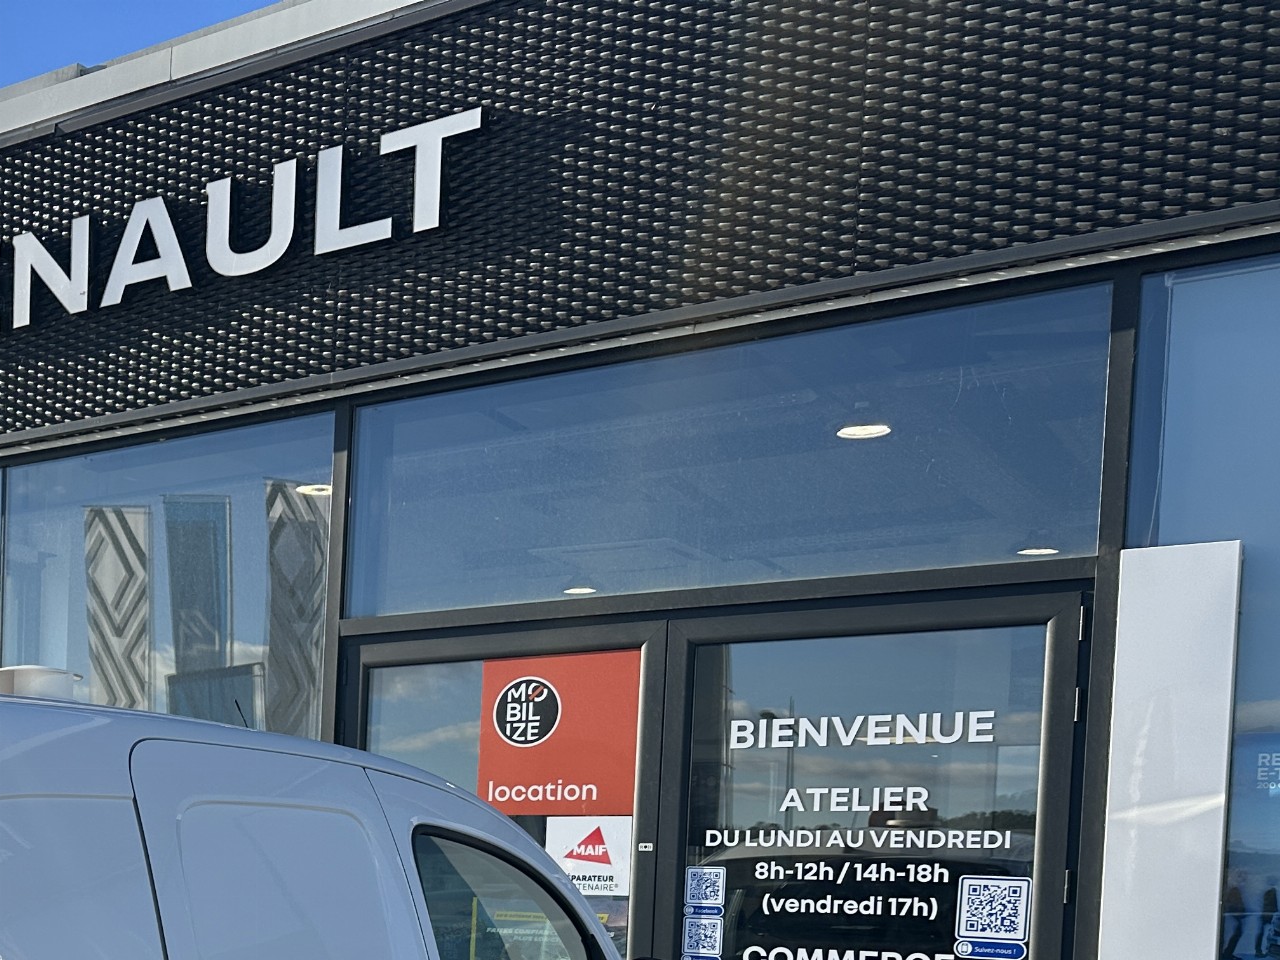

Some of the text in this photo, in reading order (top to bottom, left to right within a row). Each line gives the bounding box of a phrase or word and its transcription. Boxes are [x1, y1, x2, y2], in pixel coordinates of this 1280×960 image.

[729, 710, 996, 749] BIENVENUE
[488, 779, 598, 802] location
[779, 786, 929, 812] ATELIER
[573, 844, 607, 856] MAIF
[705, 829, 1012, 849] DU LUNDI AU VENDREDI
[761, 893, 938, 920] (vendredi 17h)
[974, 946, 1012, 955] Suivez-nous
